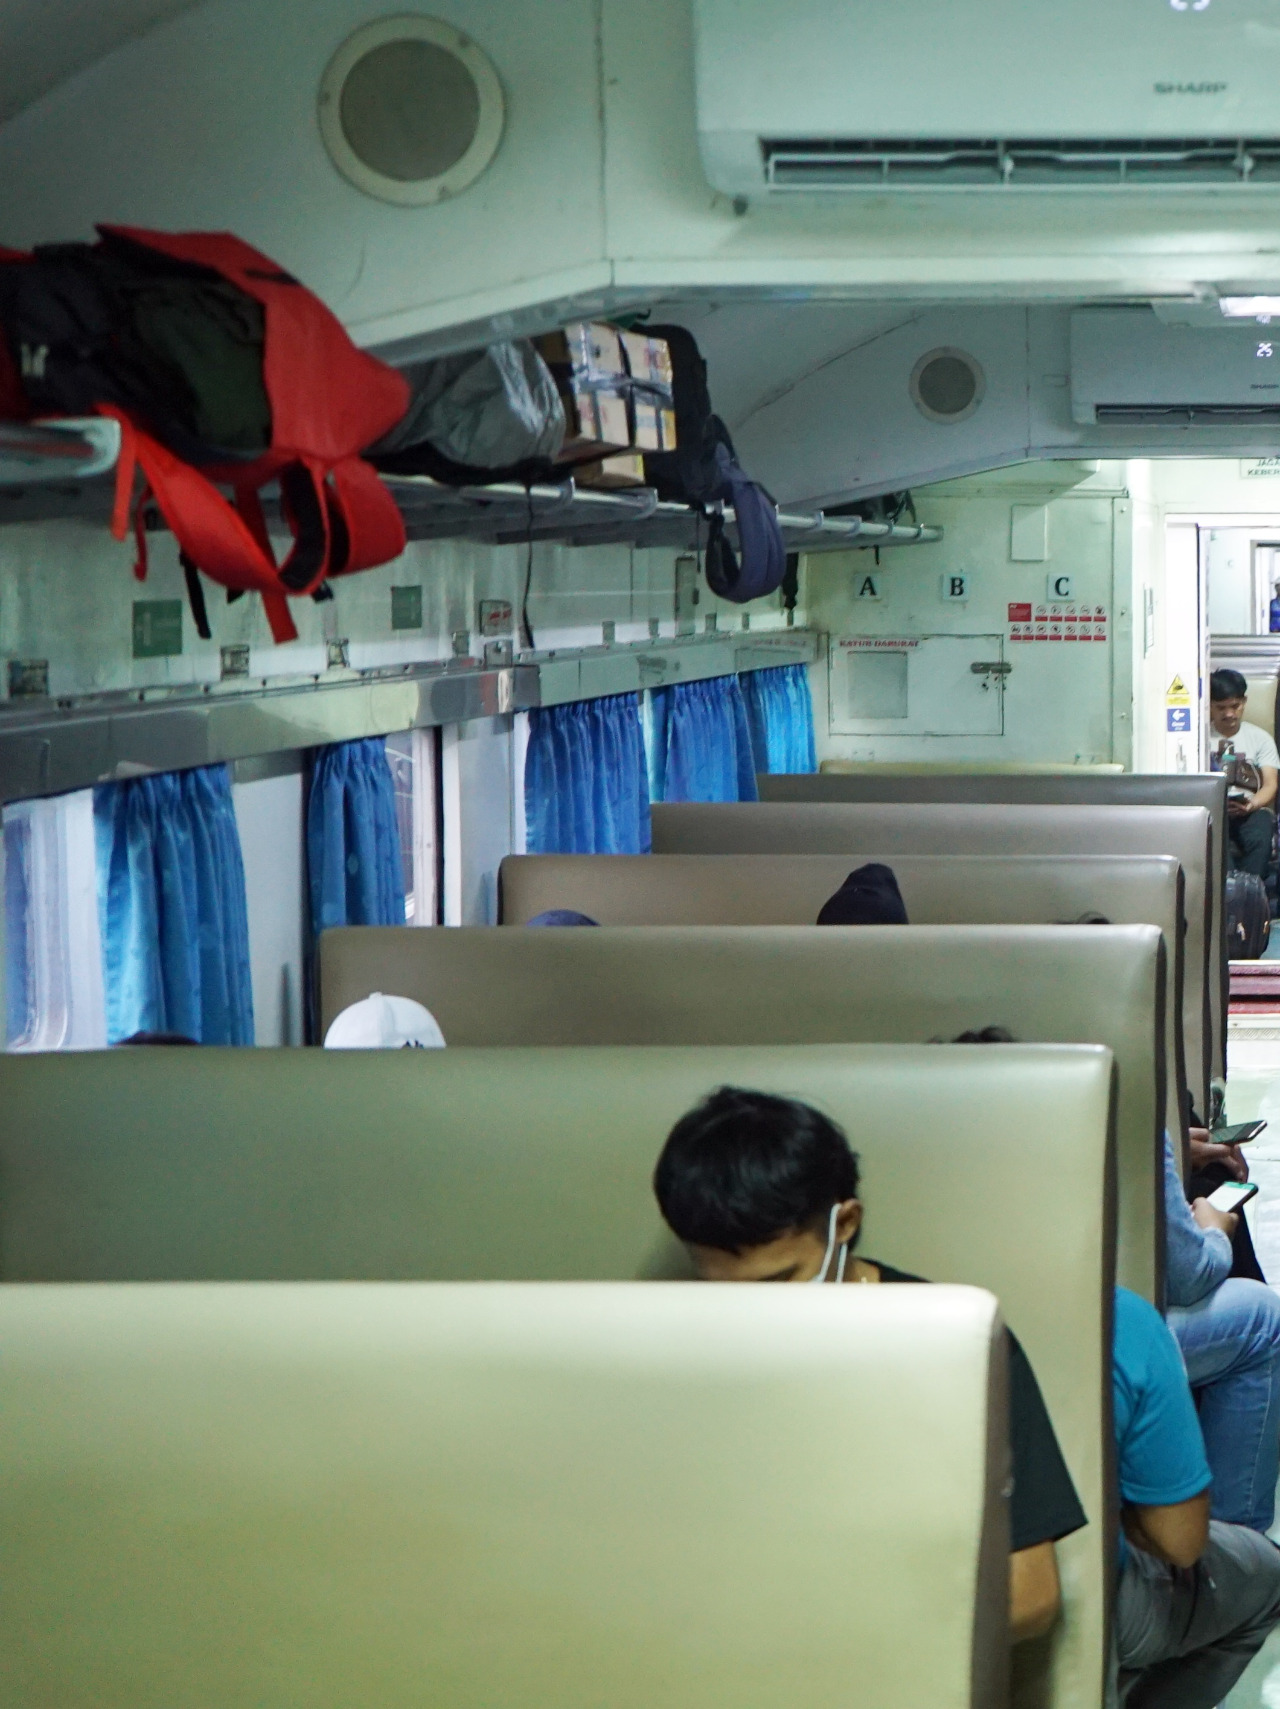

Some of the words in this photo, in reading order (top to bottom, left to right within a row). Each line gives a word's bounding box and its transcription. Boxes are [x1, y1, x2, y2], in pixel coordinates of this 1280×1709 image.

[1154, 82, 1227, 94] SHARP
[859, 576, 877, 596] A
[950, 576, 965, 596] B
[1054, 576, 1070, 596] C
